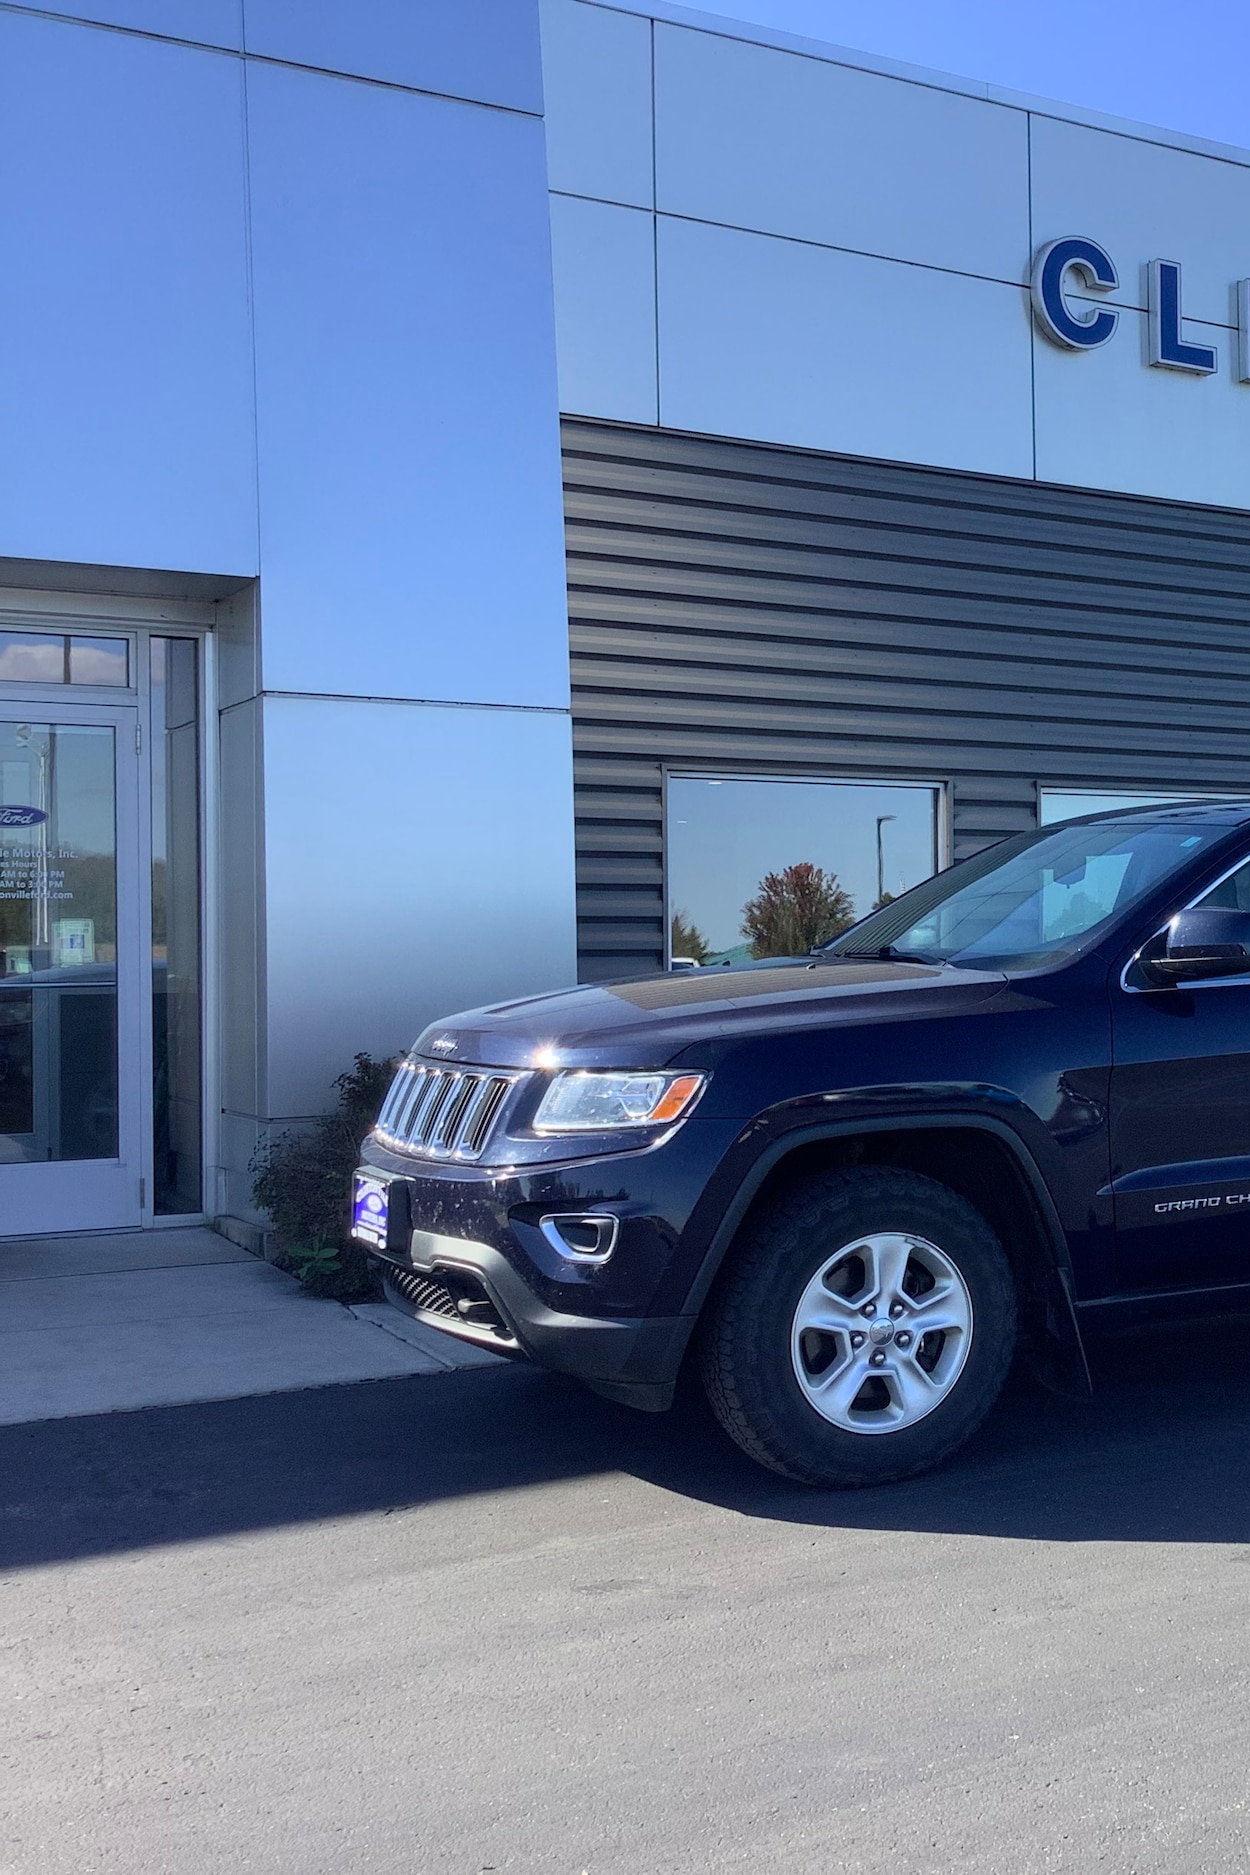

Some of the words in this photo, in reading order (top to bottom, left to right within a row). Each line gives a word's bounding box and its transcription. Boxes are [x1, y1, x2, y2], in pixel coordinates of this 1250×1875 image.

[0, 807, 34, 824] Ford
[12, 848, 56, 860] Motos,
[58, 849, 79, 859] Inc.
[11, 860, 38, 869] Hours
[0, 870, 16, 879] AM
[18, 871, 28, 879] to
[50, 870, 65, 879] PM
[0, 880, 14, 889] AM
[16, 881, 26, 889] to
[48, 880, 63, 889] PM
[1154, 1196, 1221, 1214] GRAND
